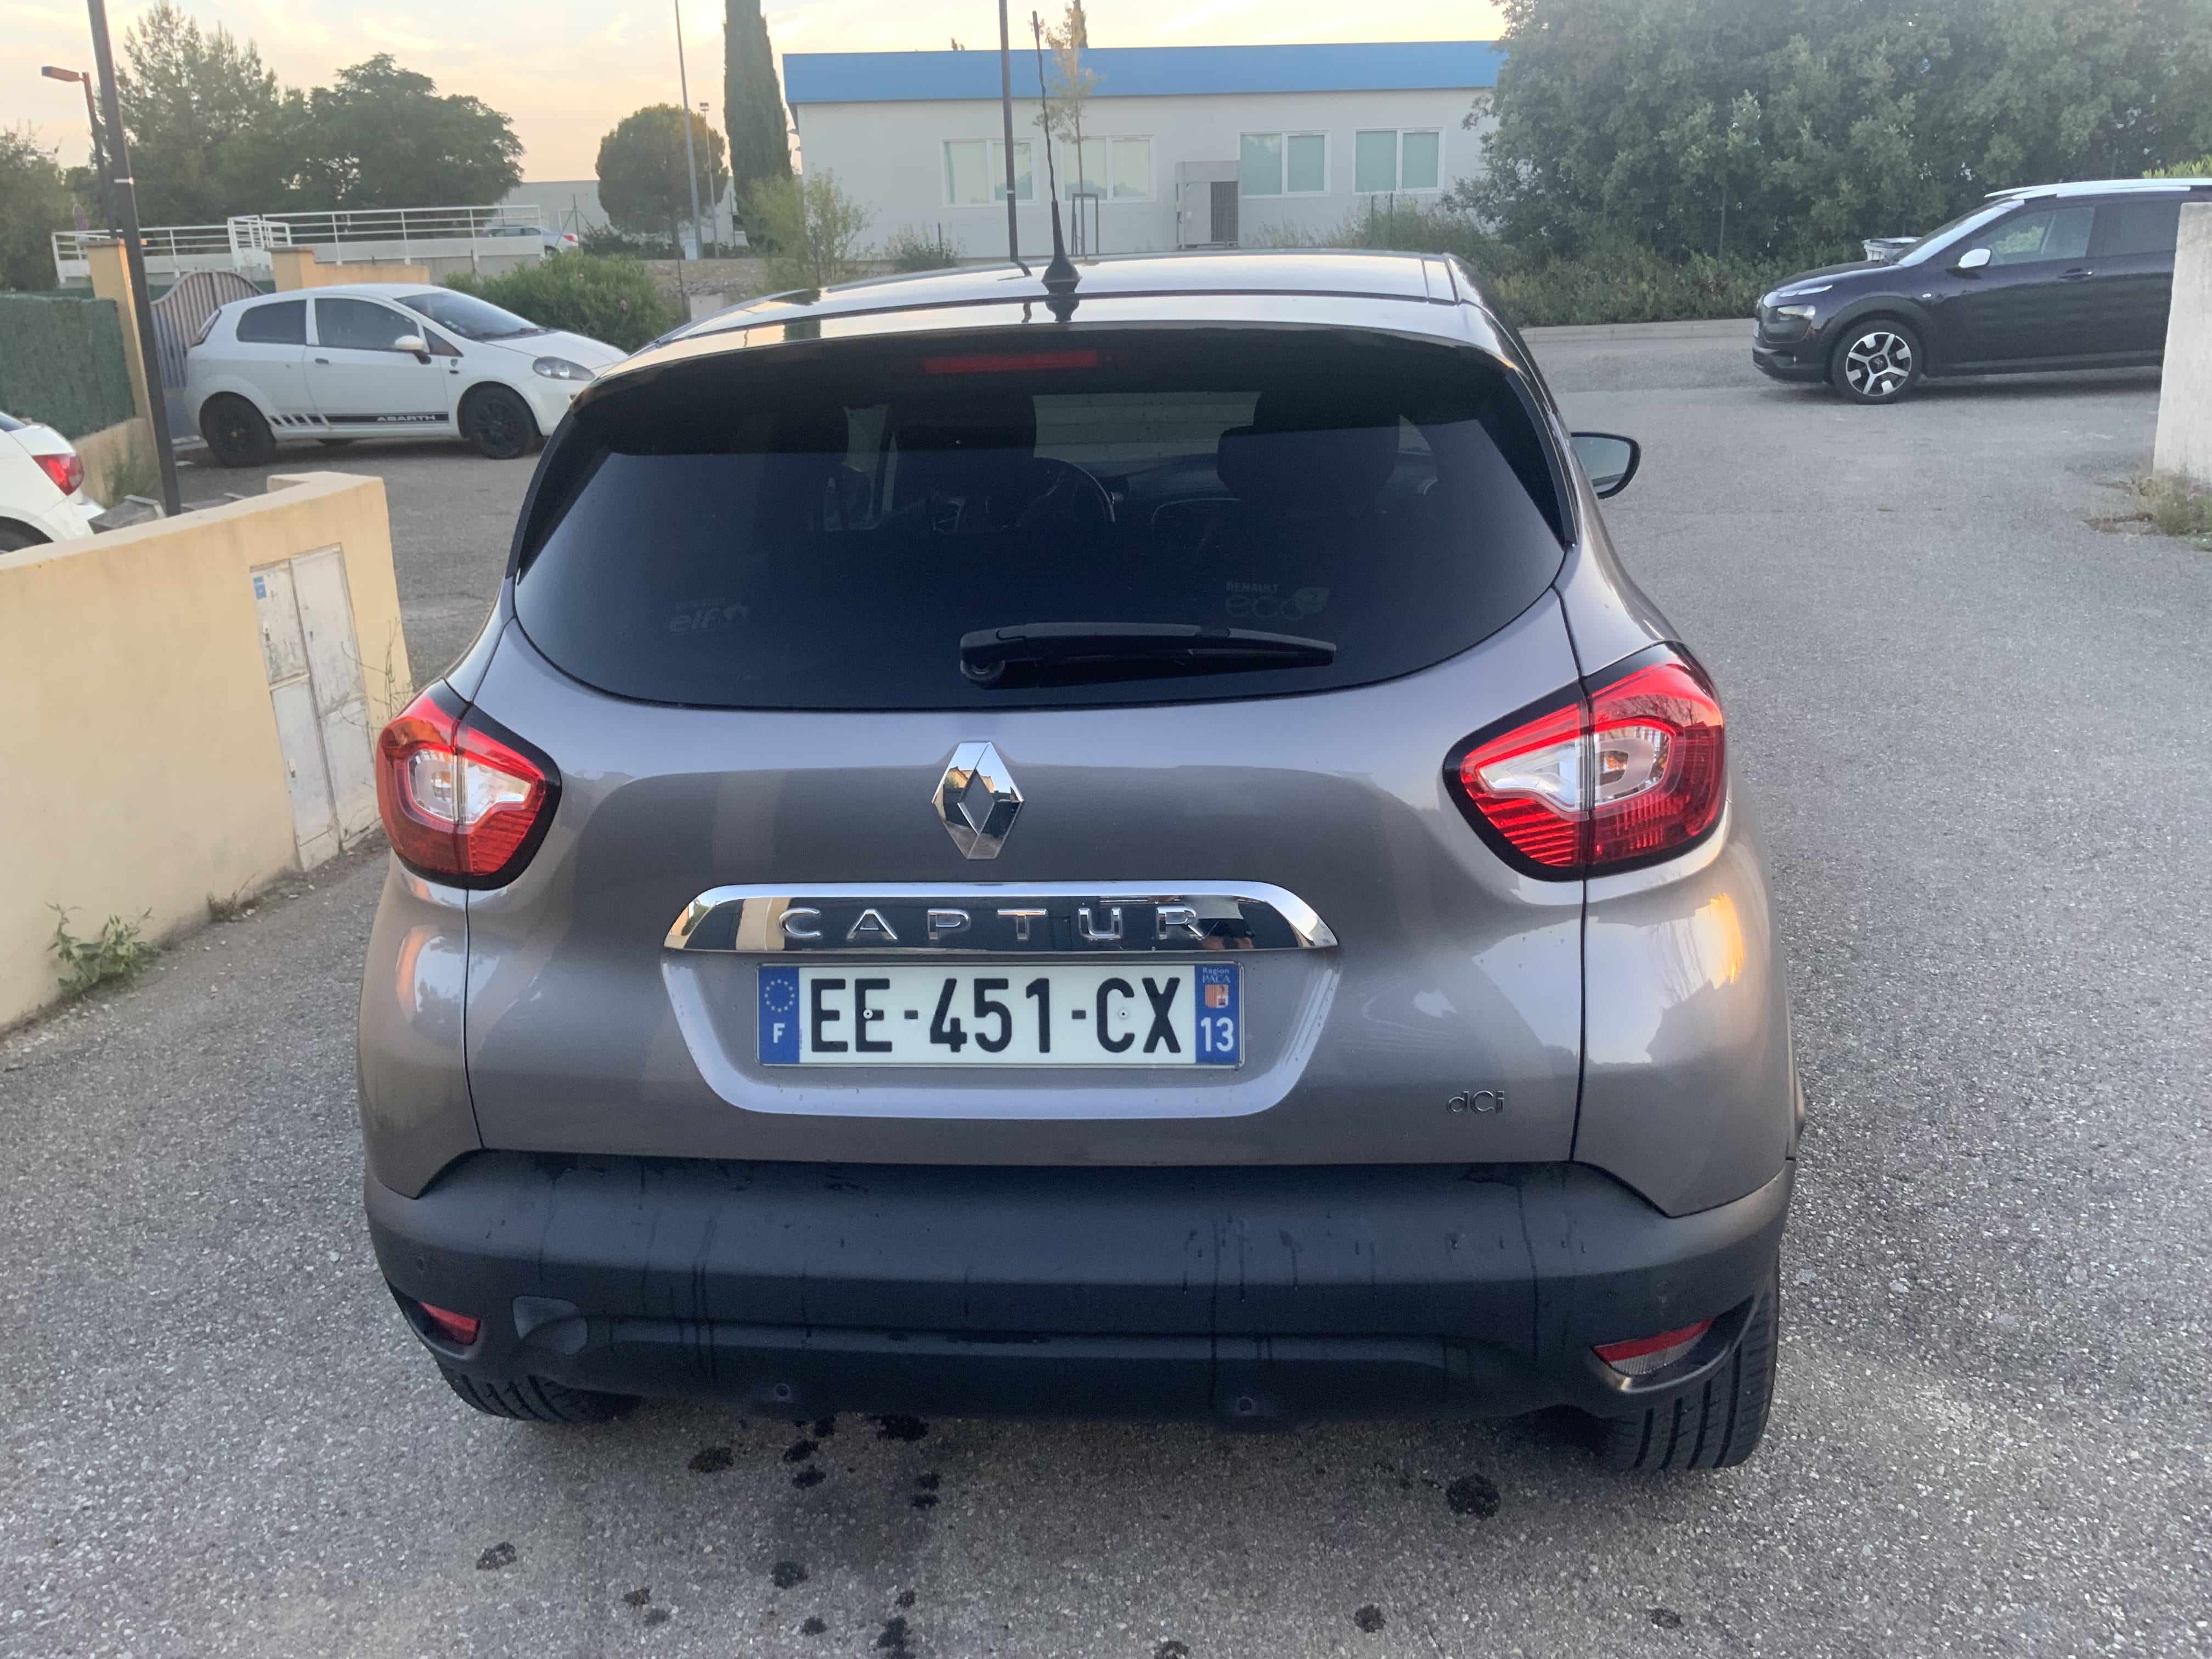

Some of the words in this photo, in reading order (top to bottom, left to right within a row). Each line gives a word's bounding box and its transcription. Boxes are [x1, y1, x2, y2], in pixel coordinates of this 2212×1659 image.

[778, 906, 1205, 941] CAPTUR
[1202, 975, 1231, 984] PACA
[810, 978, 1182, 1053] EE-451-CX
[773, 1023, 785, 1043] F
[1200, 1017, 1234, 1052] 13
[1447, 1090, 1505, 1114] dCi
